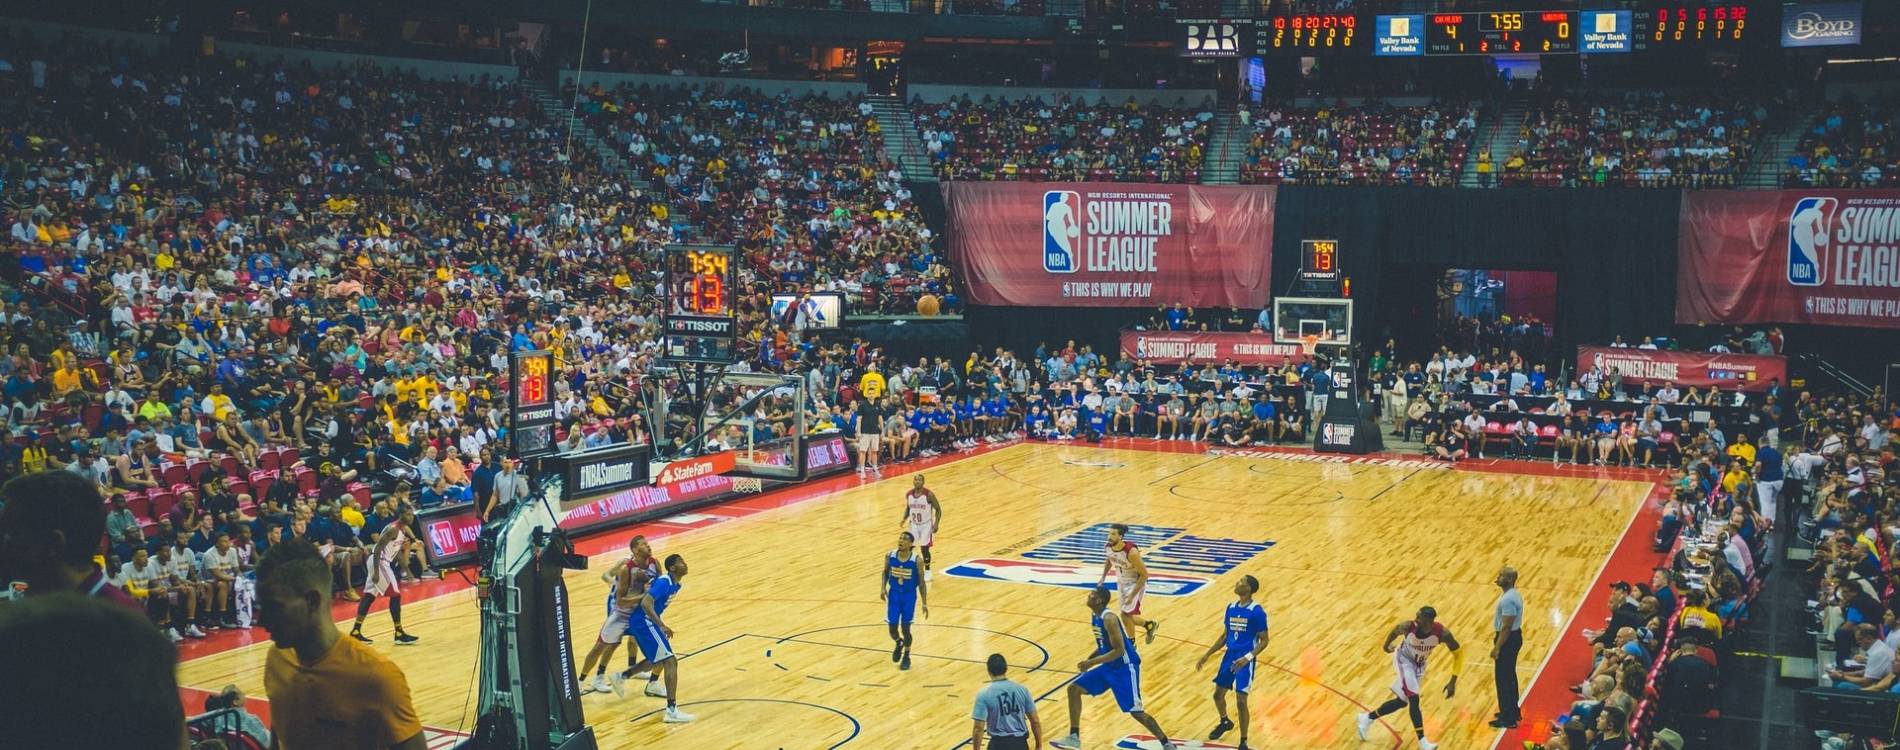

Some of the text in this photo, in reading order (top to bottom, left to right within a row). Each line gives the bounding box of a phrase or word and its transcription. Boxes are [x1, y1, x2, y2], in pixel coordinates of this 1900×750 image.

[1678, 8, 1687, 21] 5
[1714, 7, 1726, 20] 15
[1731, 7, 1747, 20] 32
[1274, 18, 1285, 29] 10
[1292, 17, 1302, 29] 18
[1305, 17, 1320, 29] 20
[1323, 16, 1337, 28] 27
[1341, 16, 1355, 28] 40
[1490, 14, 1521, 30] 7:55
[1659, 21, 1666, 31] 0
[1678, 21, 1685, 31] 0
[1698, 20, 1705, 31] 0
[1717, 20, 1725, 30] 0
[1737, 19, 1745, 30] 0
[1797, 18, 1854, 33] BOYD
[1277, 29, 1284, 38] 2
[1294, 29, 1301, 38] 0
[1311, 29, 1318, 38] 2
[1329, 28, 1336, 38] 0
[1347, 28, 1353, 37] 0
[1446, 25, 1457, 39] 4
[1559, 22, 1569, 38] 0
[1584, 32, 1627, 42] Valley Bank
[1655, 31, 1662, 41] 0
[1675, 30, 1681, 40] 0
[1734, 29, 1741, 39] 0
[1274, 38, 1281, 47] 0
[1309, 38, 1315, 46] 0
[1326, 37, 1333, 46] 0
[1344, 37, 1350, 46] 0
[1379, 37, 1420, 46] Valley Bank
[1382, 45, 1390, 53] of
[1481, 42, 1488, 52] 2
[1514, 41, 1520, 52] 2
[1543, 40, 1550, 51] 2
[1596, 41, 1624, 49] Nevada
[1087, 200, 1172, 236] SUMMER
[1087, 236, 1159, 272] LEAGUE
[1313, 242, 1333, 253] 7:54
[687, 251, 728, 275] 7:54
[1048, 252, 1066, 267] NBA
[1316, 253, 1330, 270] 13
[1792, 263, 1811, 279] NBA
[692, 276, 720, 313] 13
[1071, 282, 1152, 297] THIS IS WHY WE PLAY
[1815, 297, 1836, 314] THIS
[1836, 297, 1847, 315] IS
[1847, 298, 1868, 316] WHY
[1870, 298, 1884, 316] WE
[685, 320, 730, 332] TISSOT
[1148, 342, 1184, 359] SUMMER
[1239, 343, 1253, 355] THIS
[1253, 343, 1260, 355] IS
[1645, 361, 1679, 380] LEAGUE
[1708, 361, 1756, 371] #NBASummer
[529, 378, 542, 401] 13
[528, 409, 553, 420] TISSOT
[579, 461, 633, 490] #NBASummer
[606, 488, 644, 515] SUMMER
[642, 485, 671, 508] LEAGUE
[679, 481, 698, 495] MGM
[699, 475, 728, 490] RESORTS
[912, 512, 922, 523] 20
[438, 527, 453, 549] TV
[556, 605, 565, 640] RESORTS
[559, 640, 571, 700] INTERNATIONAL
[997, 691, 1021, 717] 134
